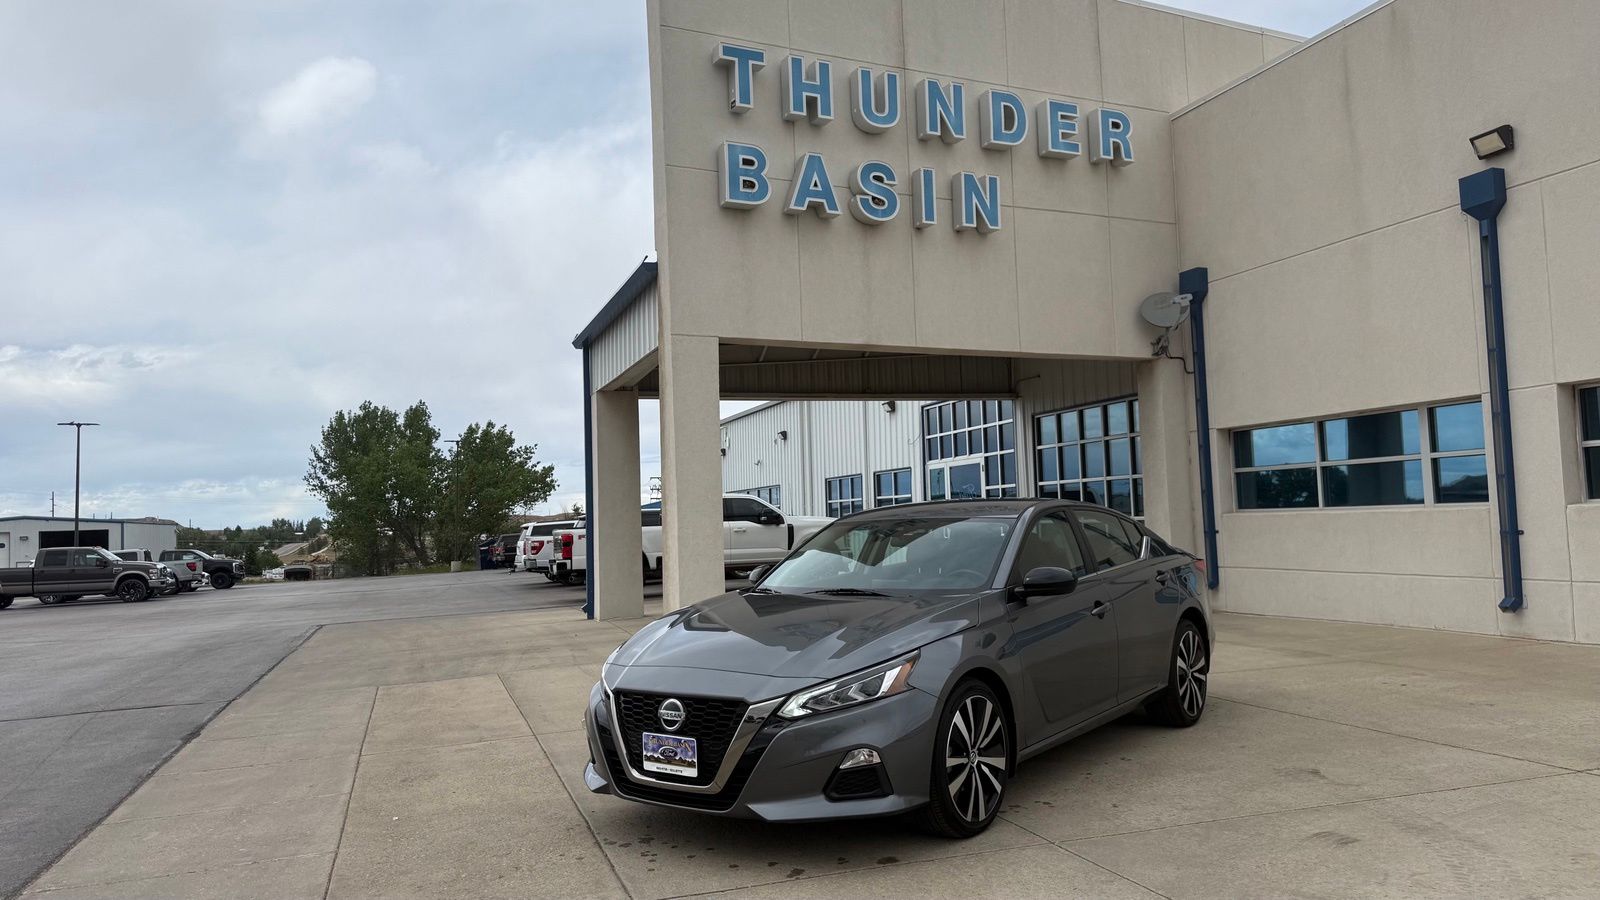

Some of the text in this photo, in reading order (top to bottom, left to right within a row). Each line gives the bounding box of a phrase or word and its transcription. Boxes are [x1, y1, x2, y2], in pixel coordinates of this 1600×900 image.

[713, 41, 1135, 167] THUNDER
[718, 140, 1001, 233] BASIN
[660, 711, 683, 719] NISSAN
